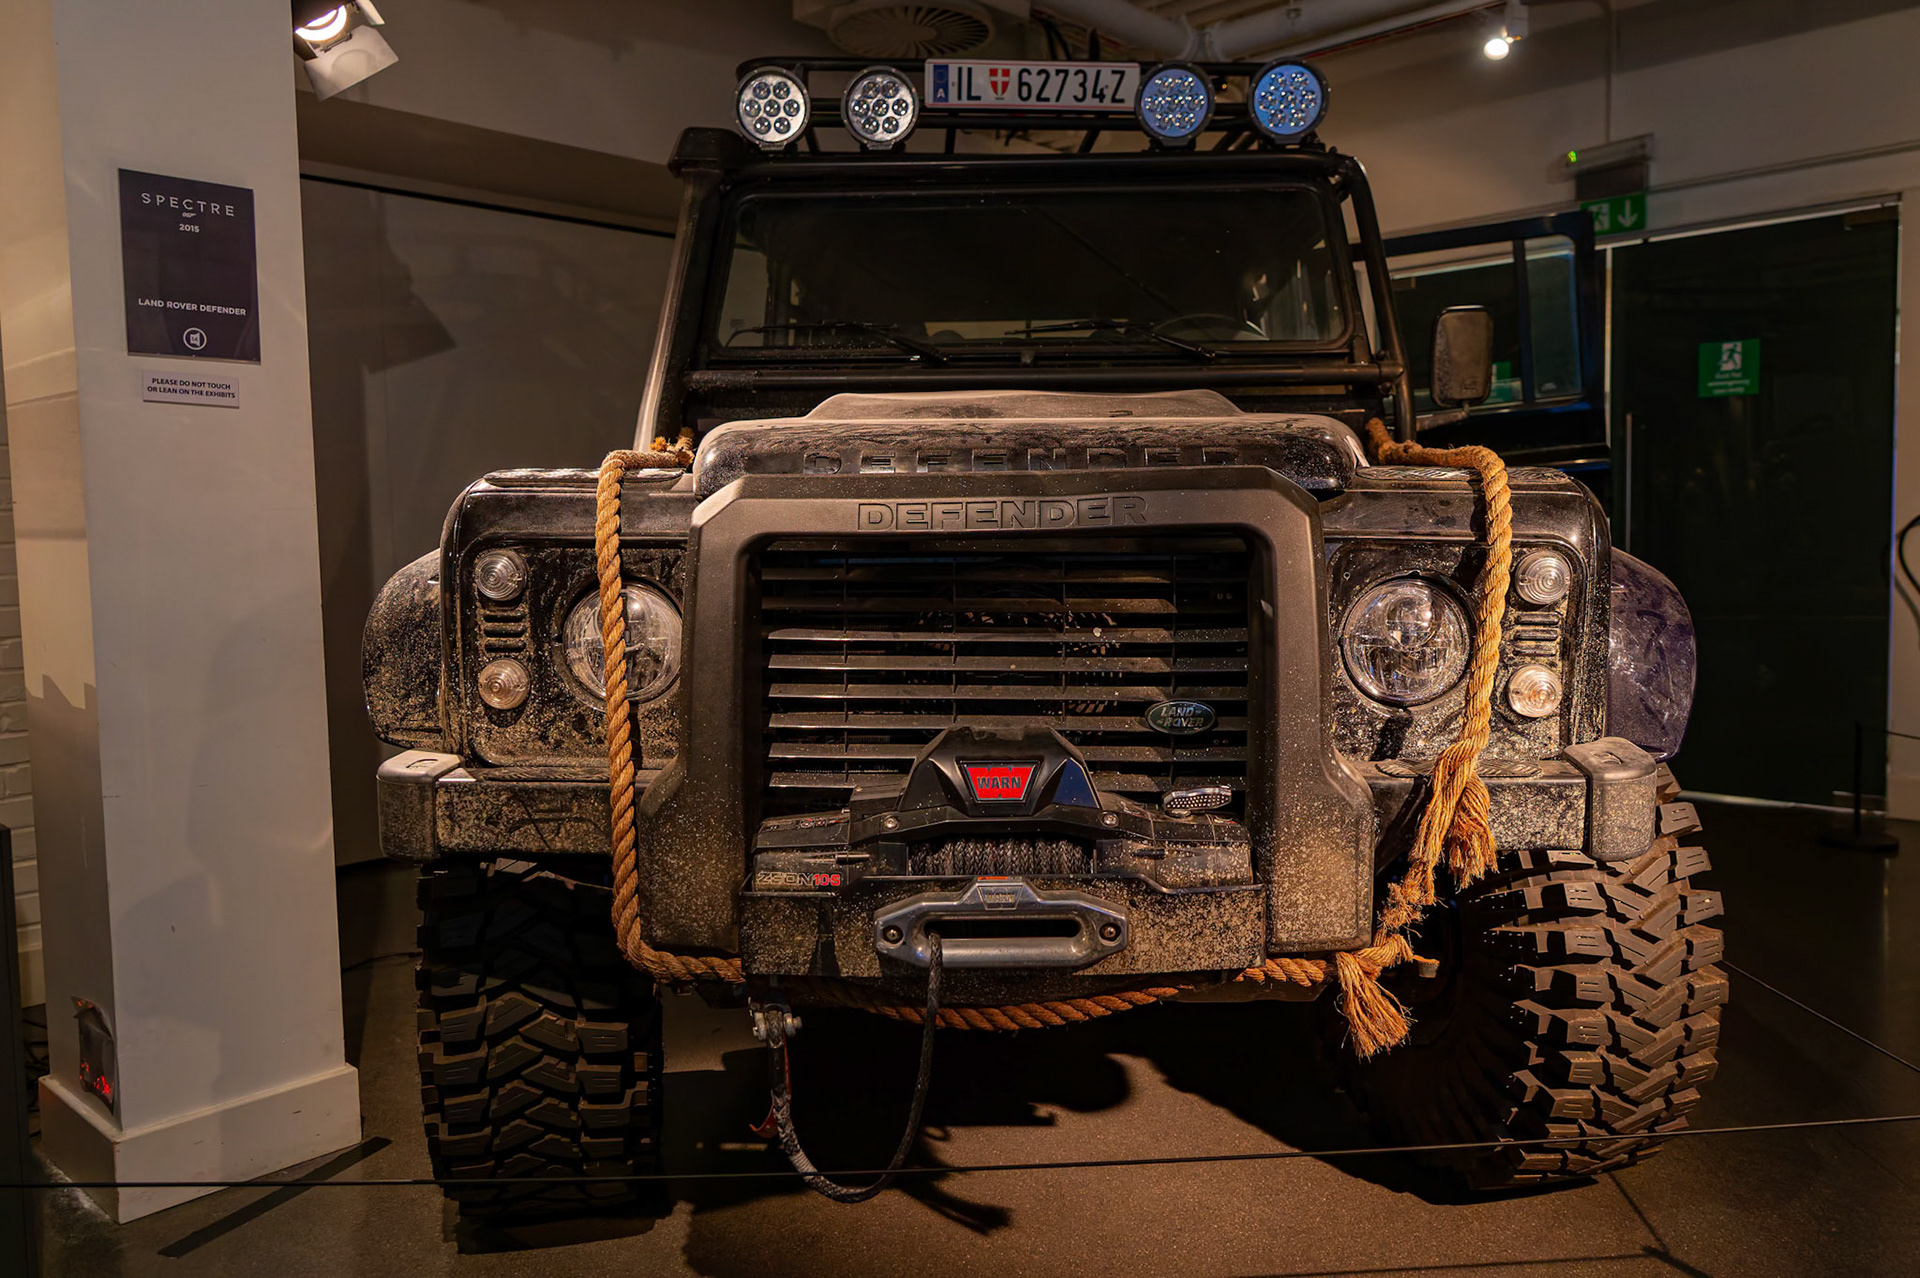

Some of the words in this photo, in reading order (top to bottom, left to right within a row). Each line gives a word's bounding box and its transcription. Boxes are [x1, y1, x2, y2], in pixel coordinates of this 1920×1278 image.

[957, 66, 982, 101] IL
[1017, 68, 1126, 103] 62734Z
[936, 88, 946, 98] A
[141, 192, 235, 217] SPECTRE
[179, 223, 200, 233] 2015
[138, 298, 165, 308] LAND
[166, 301, 198, 312] ROVER
[199, 304, 247, 316] DEFENDER
[152, 377, 178, 386] PLEASE
[179, 379, 191, 387] DO
[191, 380, 207, 389] NOT
[207, 382, 231, 390] TOUCH
[147, 385, 158, 393] OR
[158, 386, 178, 395] LEAN
[178, 388, 190, 396] ON
[190, 389, 205, 397] THE
[205, 391, 236, 399] EXHIBITS
[803, 447, 1241, 475] DEFENDER
[858, 497, 1147, 531] DEFENDER
[1161, 706, 1195, 717] LAND
[1163, 717, 1204, 727] ROVER
[977, 776, 1021, 789] WARN
